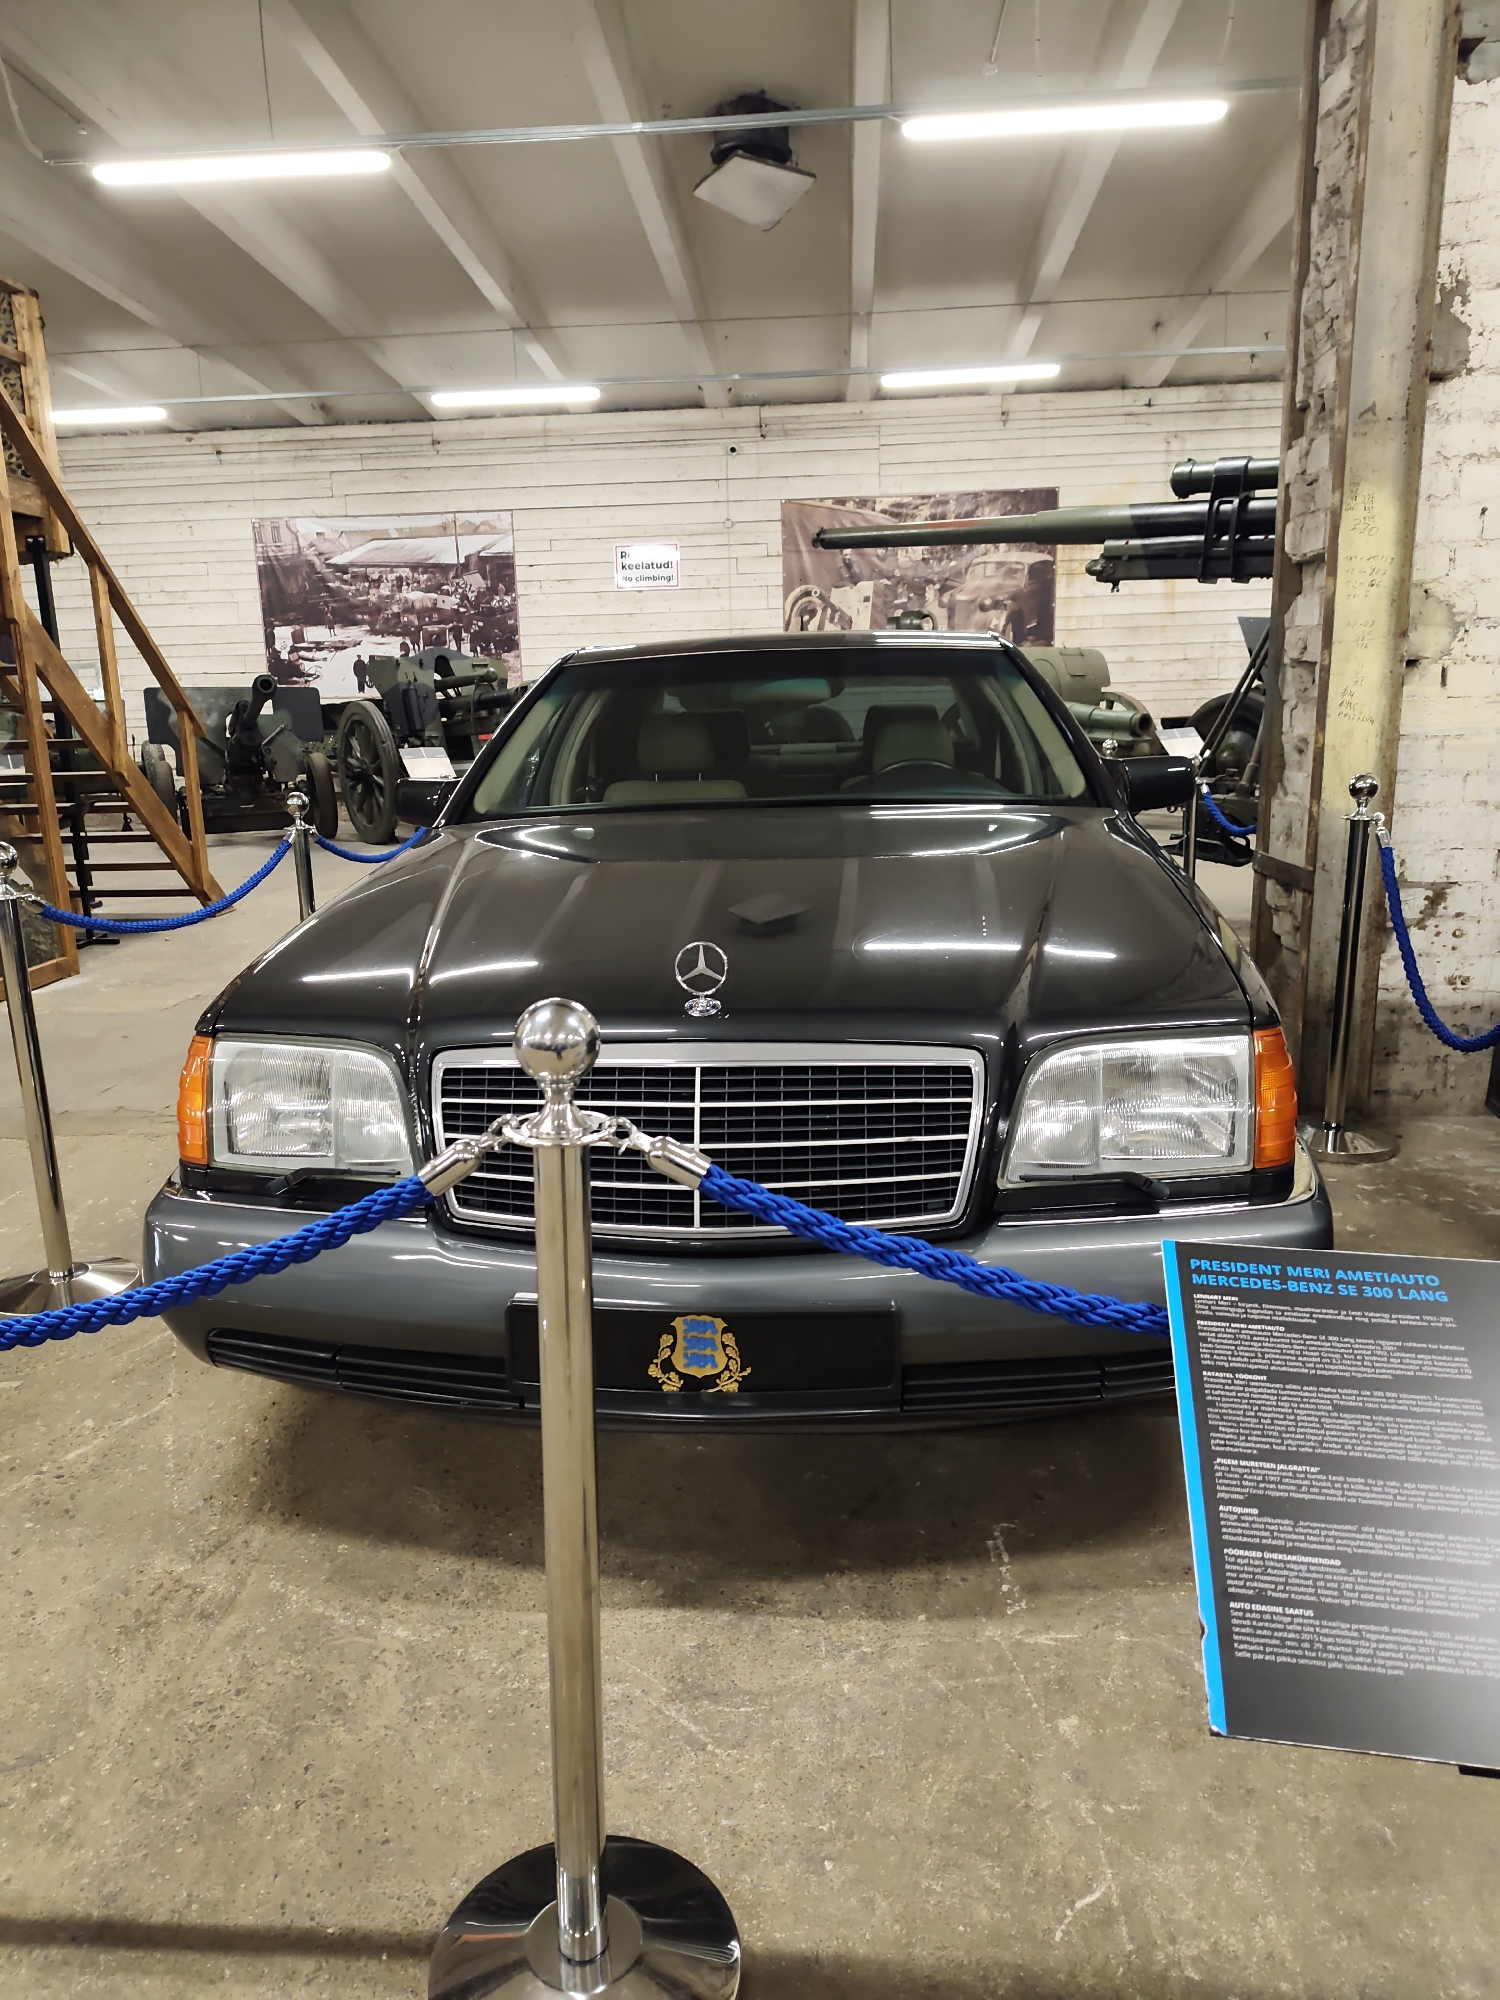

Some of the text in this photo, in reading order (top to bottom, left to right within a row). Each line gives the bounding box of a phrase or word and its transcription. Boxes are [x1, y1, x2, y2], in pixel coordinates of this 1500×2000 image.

[621, 560, 674, 571] keelatud!
[635, 574, 674, 583] climbing!
[1190, 1258, 1440, 1287] PRESIDENT MERI AMETIAUTO
[1191, 1273, 1449, 1302] MERCEDES-BENZ SE 300 LANG
